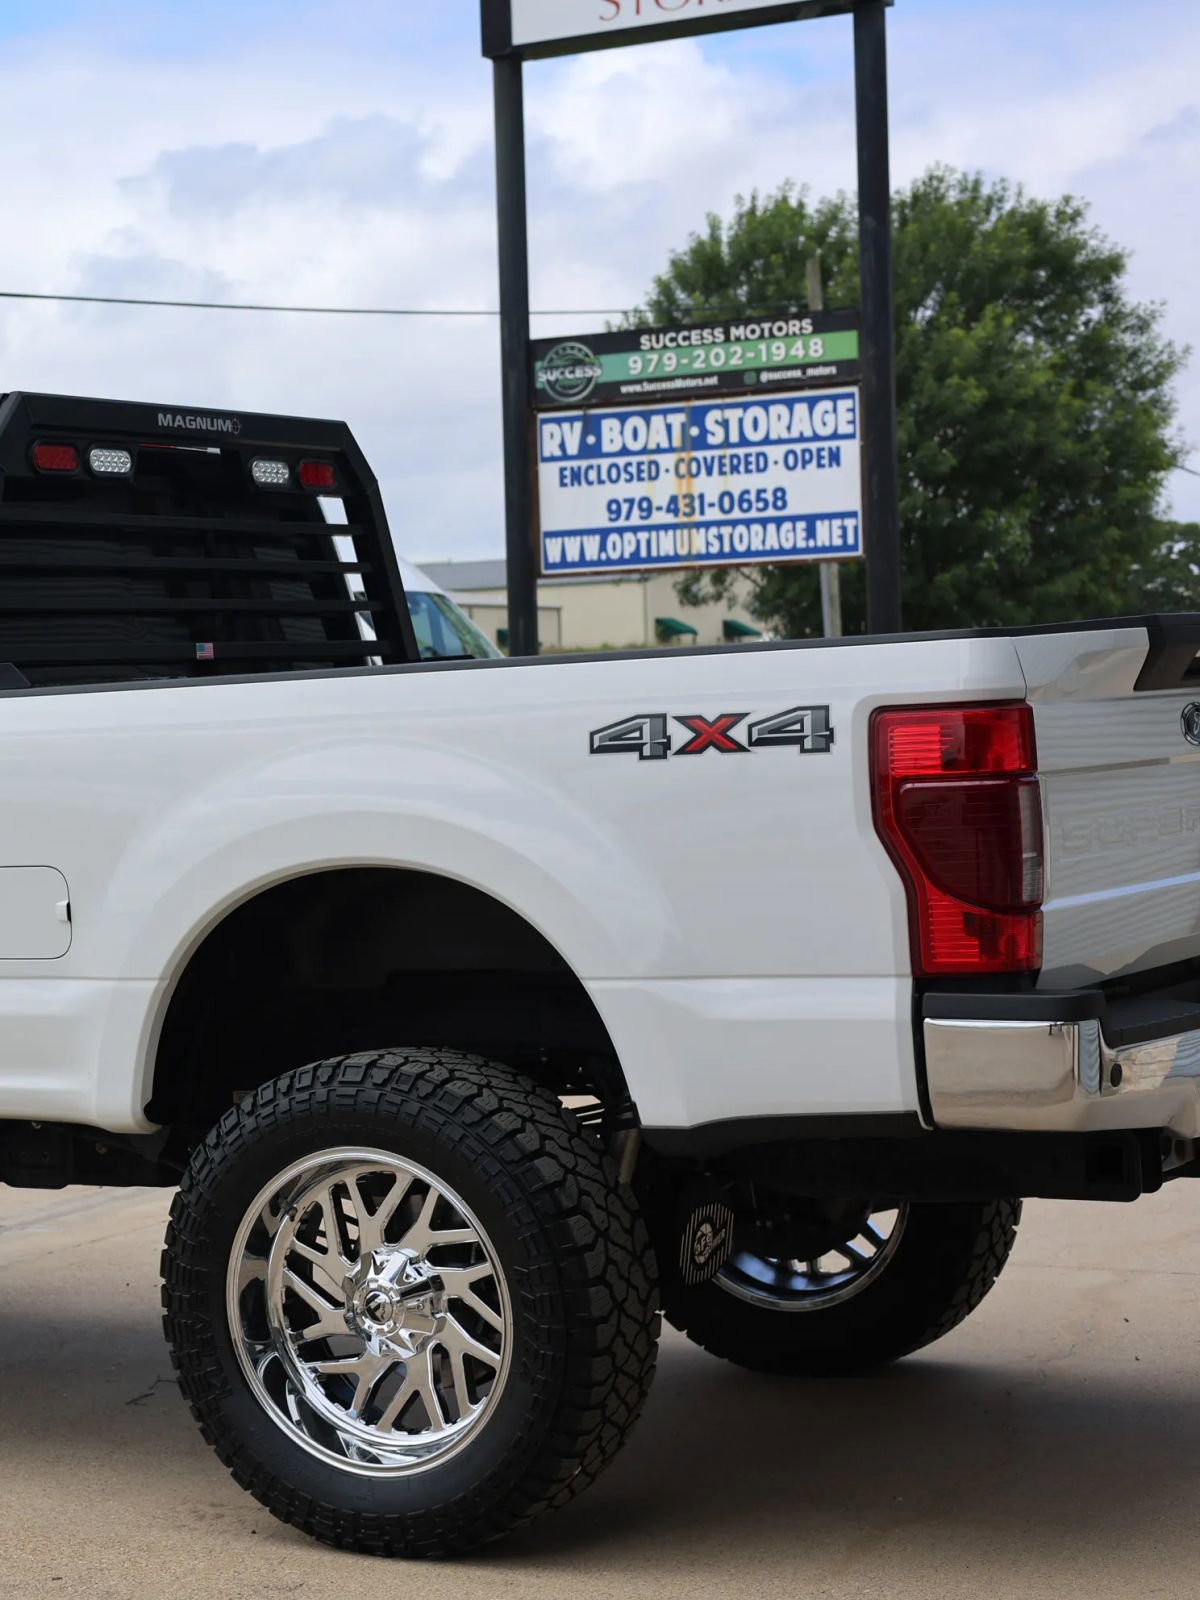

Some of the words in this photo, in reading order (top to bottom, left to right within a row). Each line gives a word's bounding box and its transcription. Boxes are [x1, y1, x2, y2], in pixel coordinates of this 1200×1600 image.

[640, 328, 725, 351] SUCCESS
[730, 318, 813, 341] MOTORS
[628, 337, 824, 375] 979-202-1948
[537, 366, 602, 383] SUCCESS
[157, 413, 232, 433] MAGNUM
[541, 420, 583, 458] RV
[601, 412, 687, 453] BOAT
[704, 398, 855, 446] STORAGE
[558, 459, 661, 488] ENCLOSED
[674, 450, 769, 480] COVERED
[783, 445, 841, 472] OPEN
[606, 487, 788, 522] 979-431-0658
[544, 517, 857, 564] WWW.OPTIMUMSTORAGE.NET
